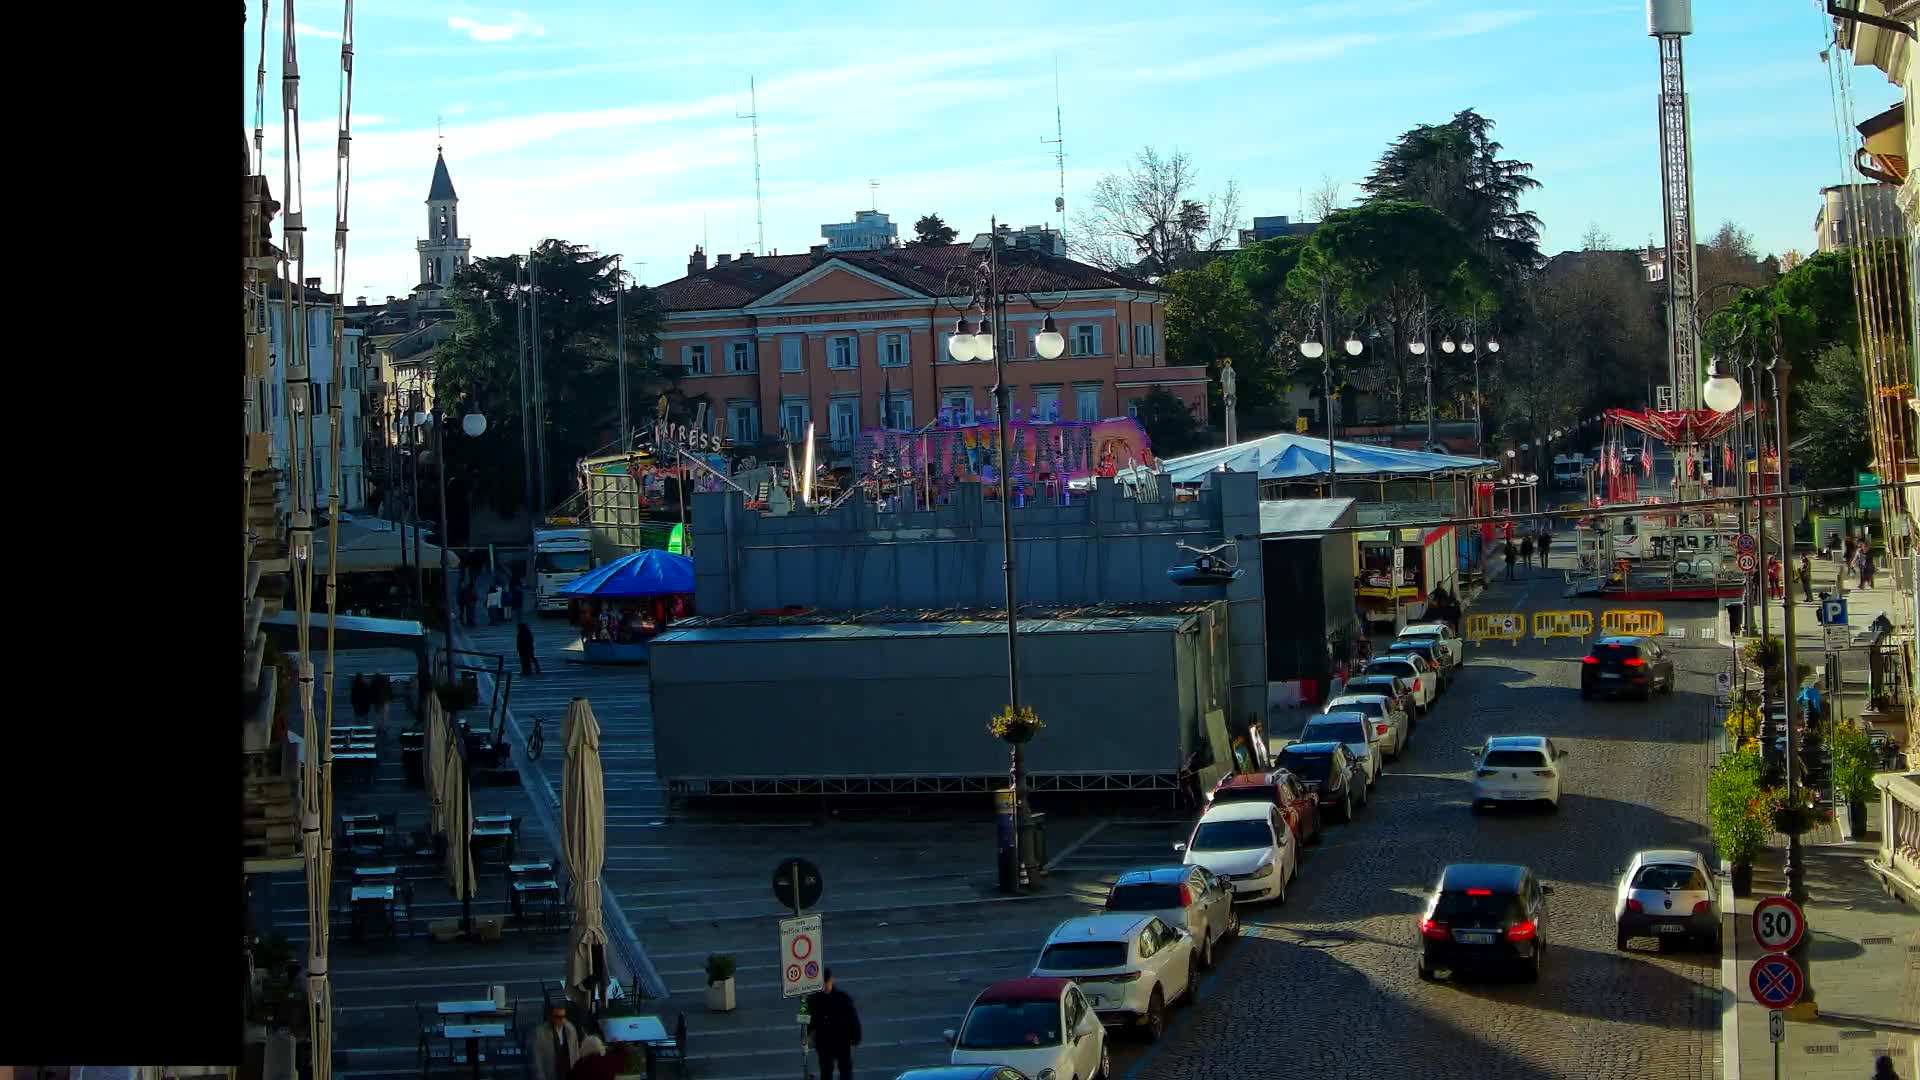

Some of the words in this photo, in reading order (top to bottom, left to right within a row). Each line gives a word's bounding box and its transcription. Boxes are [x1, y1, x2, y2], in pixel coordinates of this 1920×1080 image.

[1742, 558, 1753, 567] 20
[1828, 602, 1842, 622] P
[1762, 911, 1792, 938] 30
